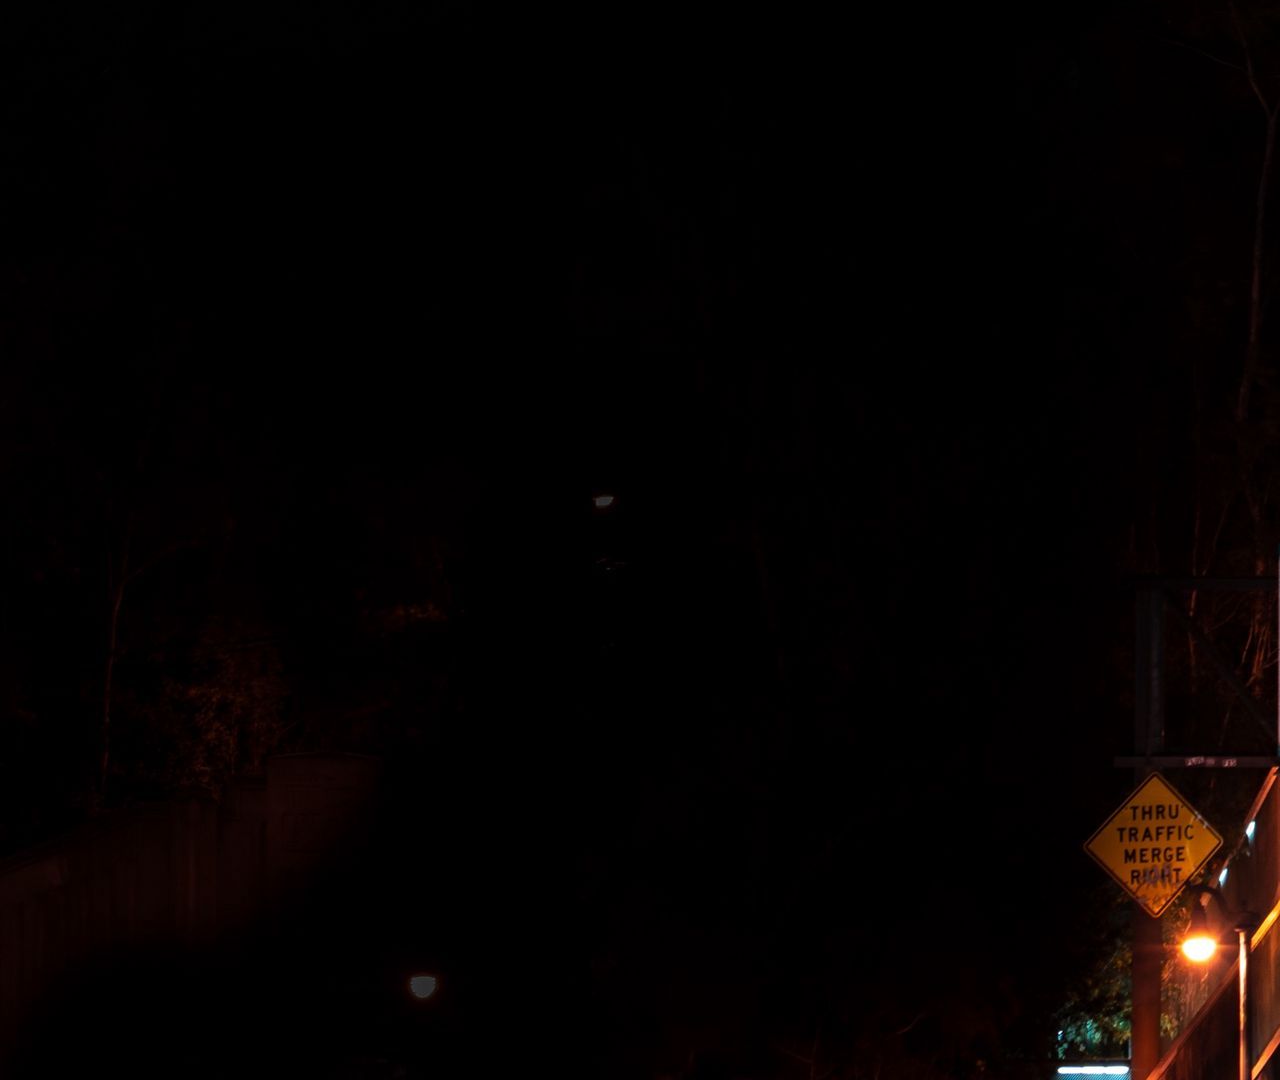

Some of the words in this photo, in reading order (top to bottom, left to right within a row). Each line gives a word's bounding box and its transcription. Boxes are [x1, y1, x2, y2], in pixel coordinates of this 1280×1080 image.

[1131, 804, 1179, 820] THRU
[1118, 824, 1194, 842] TRAFFIC
[1124, 847, 1185, 863] MERGE
[1131, 868, 1182, 885] RIGHT
